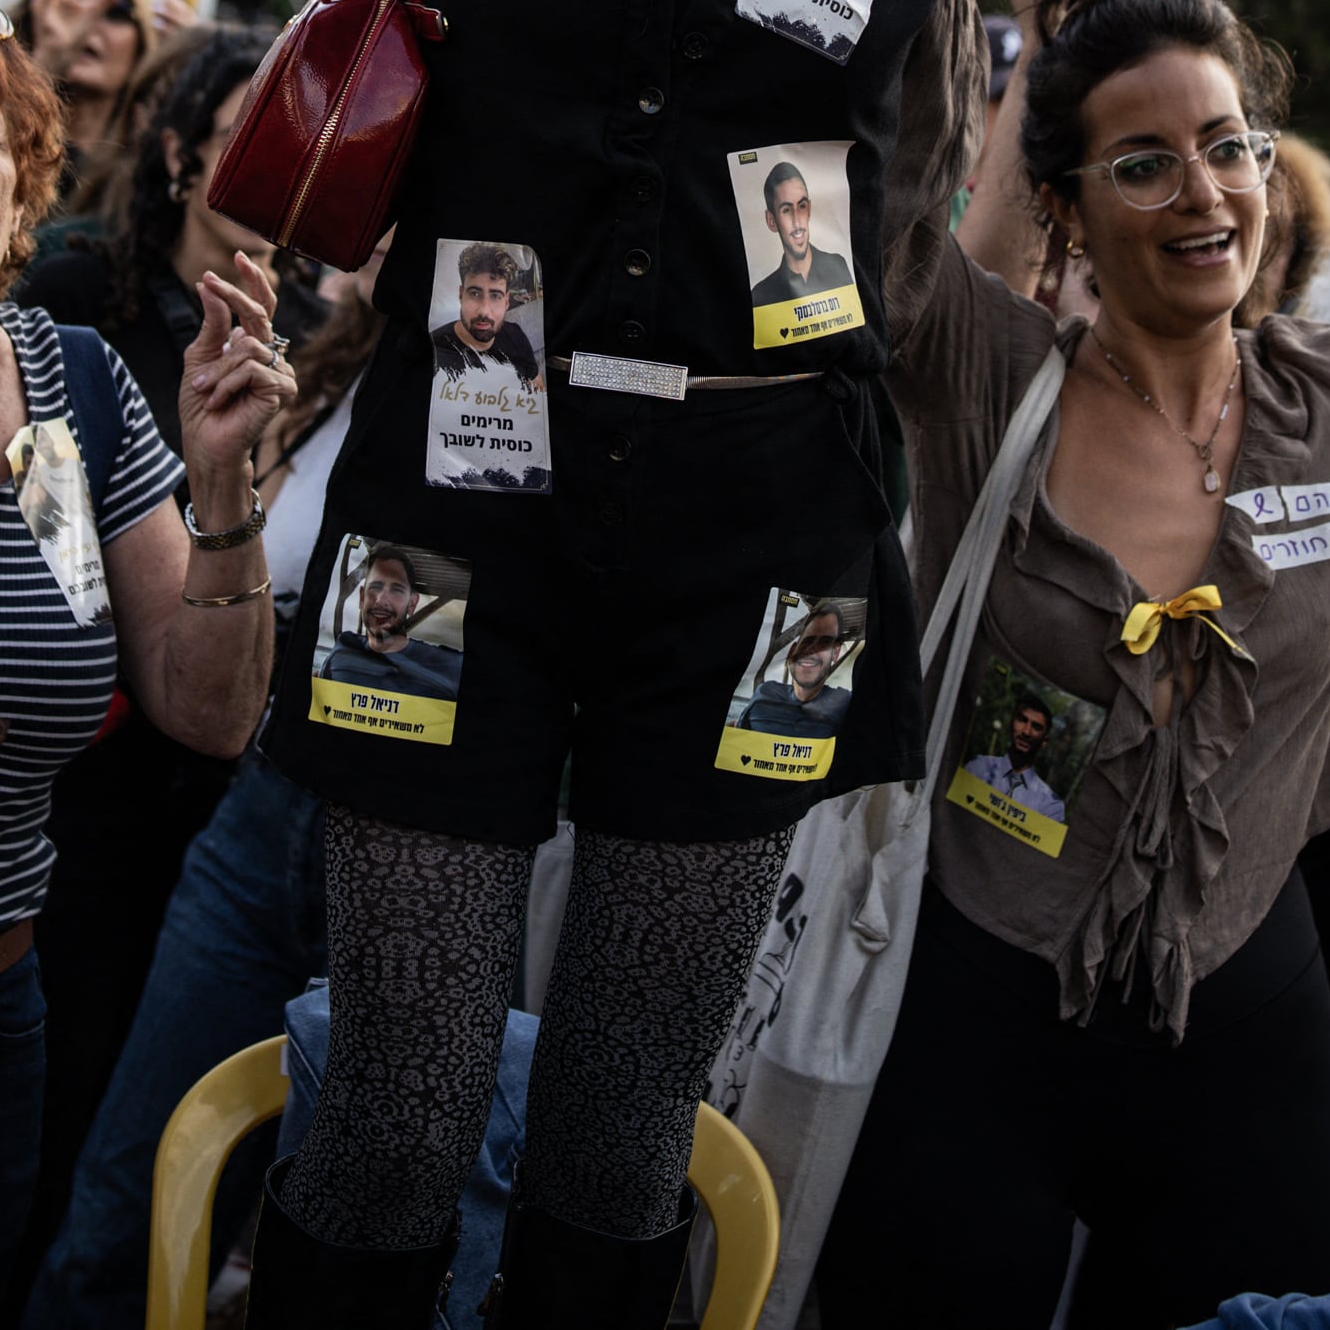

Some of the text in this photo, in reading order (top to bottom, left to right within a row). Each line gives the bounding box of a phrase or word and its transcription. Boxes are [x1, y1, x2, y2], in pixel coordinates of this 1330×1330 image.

[460, 414, 514, 431] מרימים
[439, 431, 533, 453] כוסית לשובך
[1295, 492, 1330, 512] הם
[1259, 536, 1328, 561] חוזרים
[350, 692, 399, 714] דניאל פרץ
[332, 709, 425, 734] לא משאירים אף אחד מאחור
[773, 742, 812, 759] דניאל פרץ
[753, 758, 775, 771] מאחור
